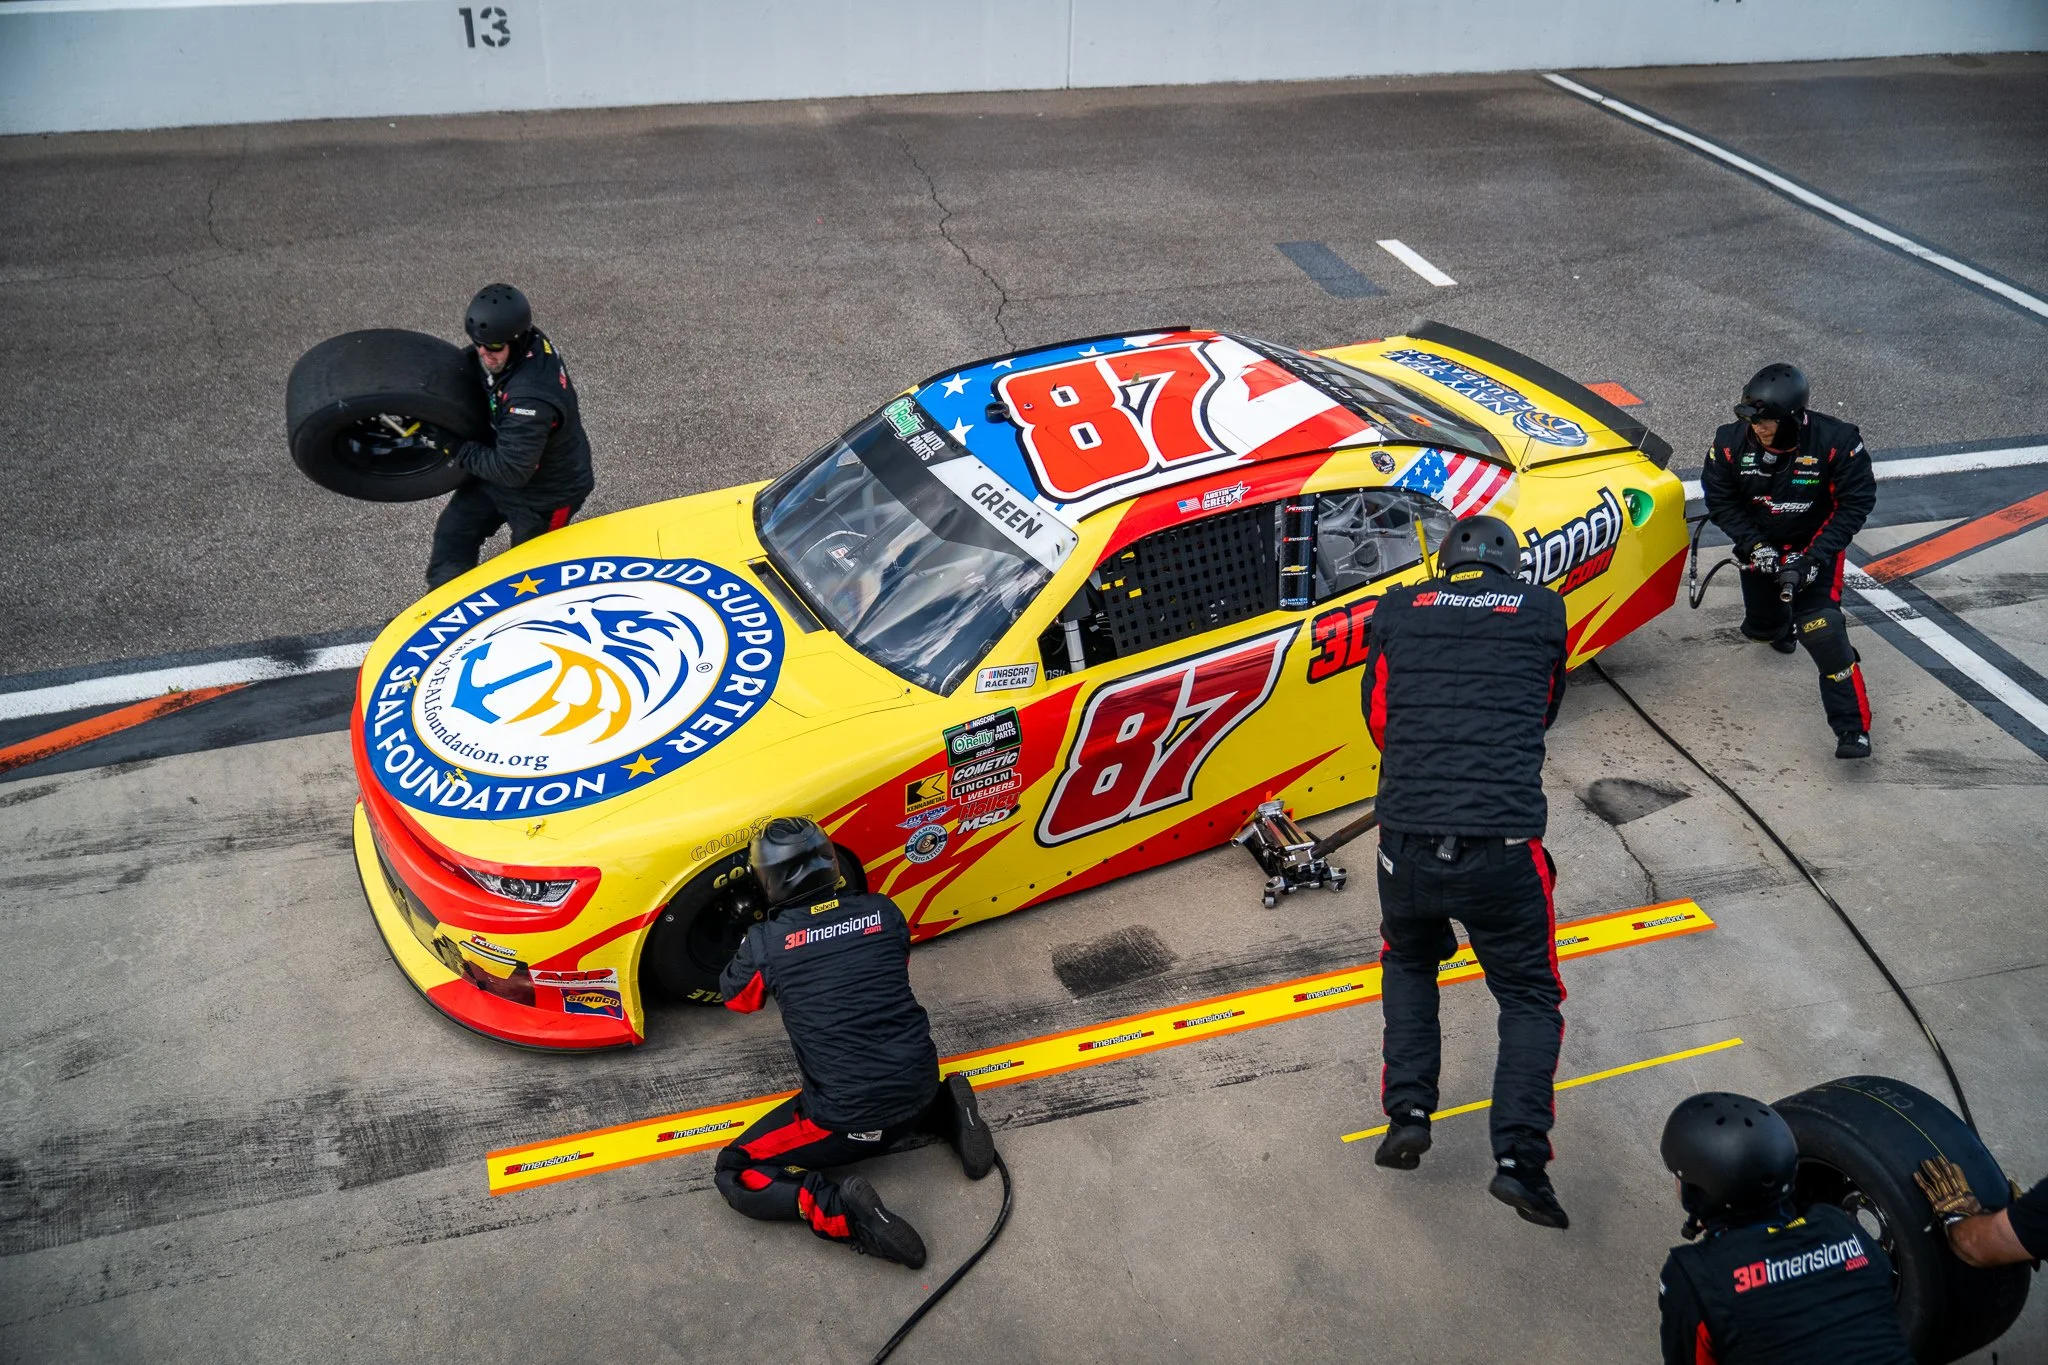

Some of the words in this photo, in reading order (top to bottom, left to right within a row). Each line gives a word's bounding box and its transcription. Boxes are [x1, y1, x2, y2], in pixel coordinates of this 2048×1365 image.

[458, 7, 510, 48] 13
[1380, 350, 1443, 378] SEAL
[1402, 349, 1532, 412] FOUNDATION
[1441, 379, 1515, 414] NAVY
[994, 341, 1230, 503] 87
[907, 435, 936, 462] PARTS
[921, 430, 946, 451] AUTO
[1204, 494, 1232, 509] GREEN
[1205, 488, 1230, 500] AUSTIN
[971, 482, 1044, 540] GREEN
[560, 560, 713, 586] PROUD
[1559, 546, 1614, 594] .com
[406, 592, 501, 661] NAVY
[665, 582, 776, 755] SUPPORTER
[996, 666, 1030, 679] NASCAR
[984, 678, 1008, 688] RACE
[1010, 677, 1028, 685] CAR
[374, 665, 421, 739] SEAL
[423, 637, 550, 771] navySEALfoundation.org
[972, 714, 995, 728] NASCAR
[994, 727, 1017, 741] PARTS
[995, 721, 1014, 733] AUTO
[953, 730, 995, 754] O'Reilly
[1037, 627, 1297, 846] 87
[975, 746, 996, 758] SERIES
[376, 726, 606, 812] FOUNDATION
[953, 751, 1018, 782] COMETIC
[954, 771, 1010, 797] LINCOLN
[967, 780, 1016, 801] WELDERS
[906, 795, 946, 813] KENNAMETAL
[958, 792, 1021, 822] Holley
[909, 825, 944, 844] CHAMPION
[957, 808, 1012, 835] MSD
[908, 843, 944, 862] IRRIGATION
[784, 910, 881, 951] 3Dimensional
[863, 924, 882, 936] .com
[474, 937, 517, 955] PETERSON
[535, 968, 614, 982] ARP
[568, 994, 619, 1006] SUNOCO
[1732, 1233, 1865, 1294] 3Dimensional
[1845, 1254, 1870, 1272] .com
